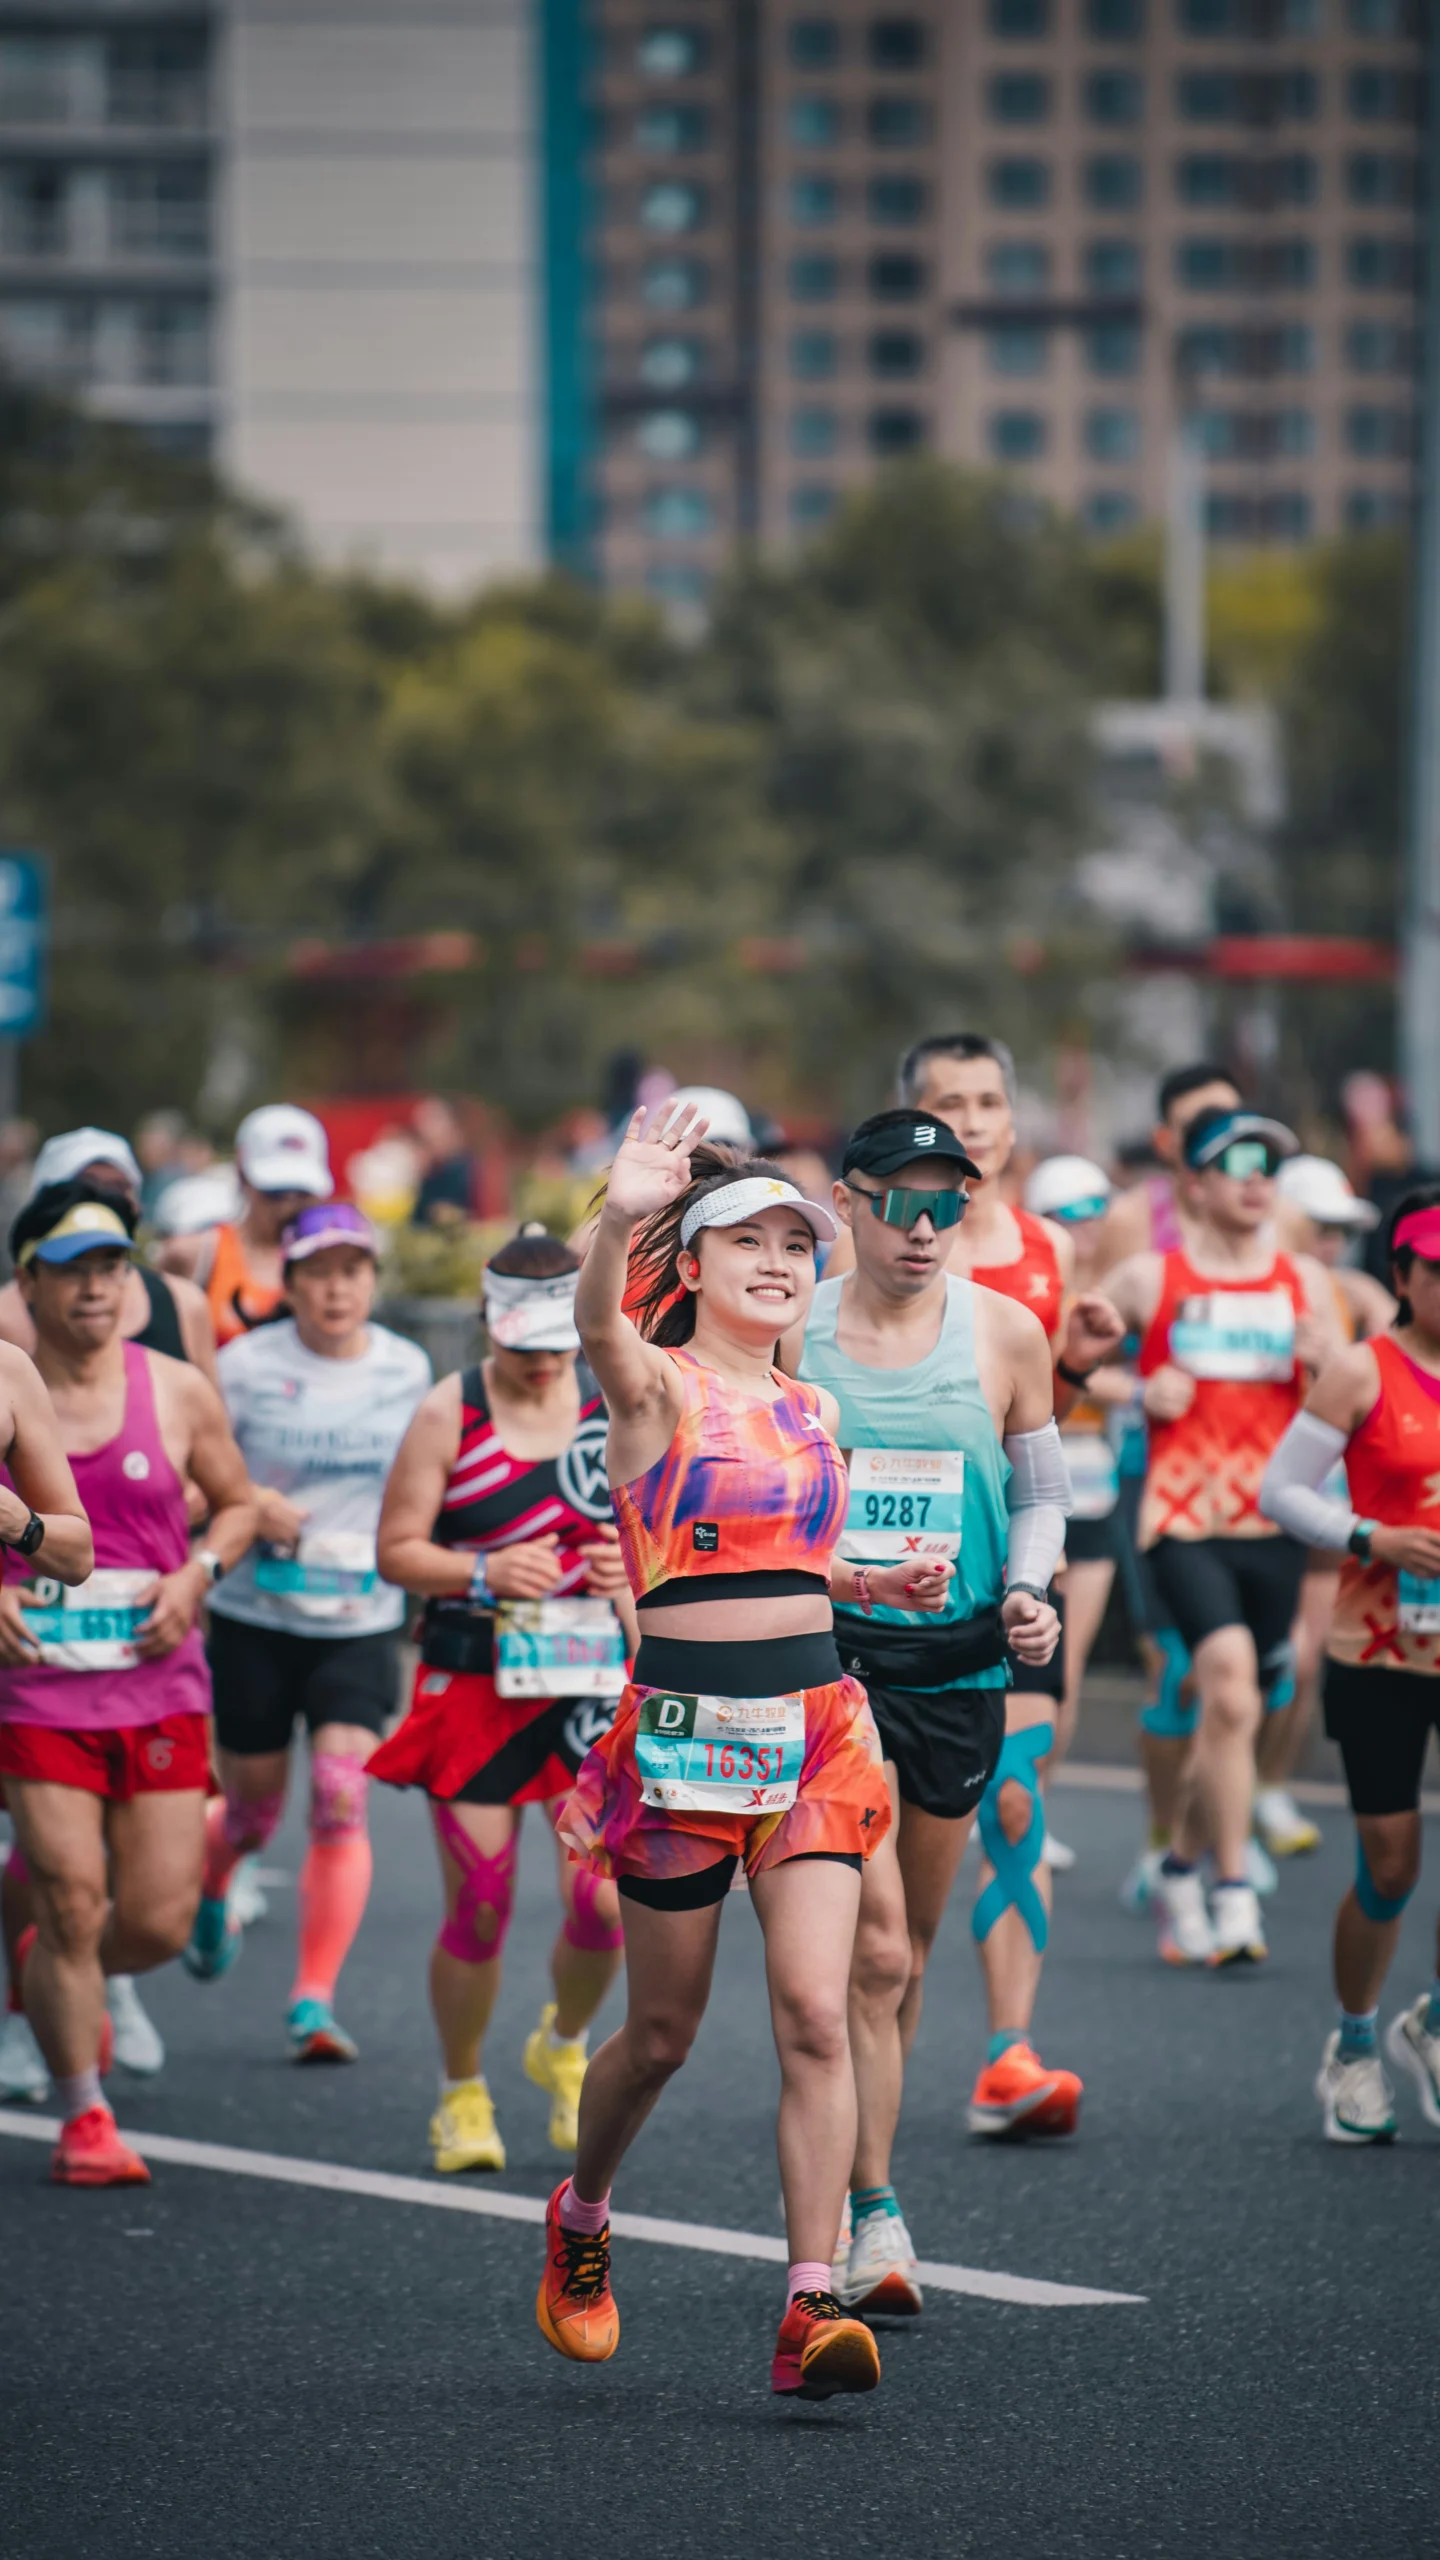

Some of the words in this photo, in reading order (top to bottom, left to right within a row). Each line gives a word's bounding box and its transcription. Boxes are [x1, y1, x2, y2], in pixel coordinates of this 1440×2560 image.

[865, 1494, 932, 1527] 9287
[657, 1699, 686, 1728] D
[704, 1744, 783, 1780] 16351
